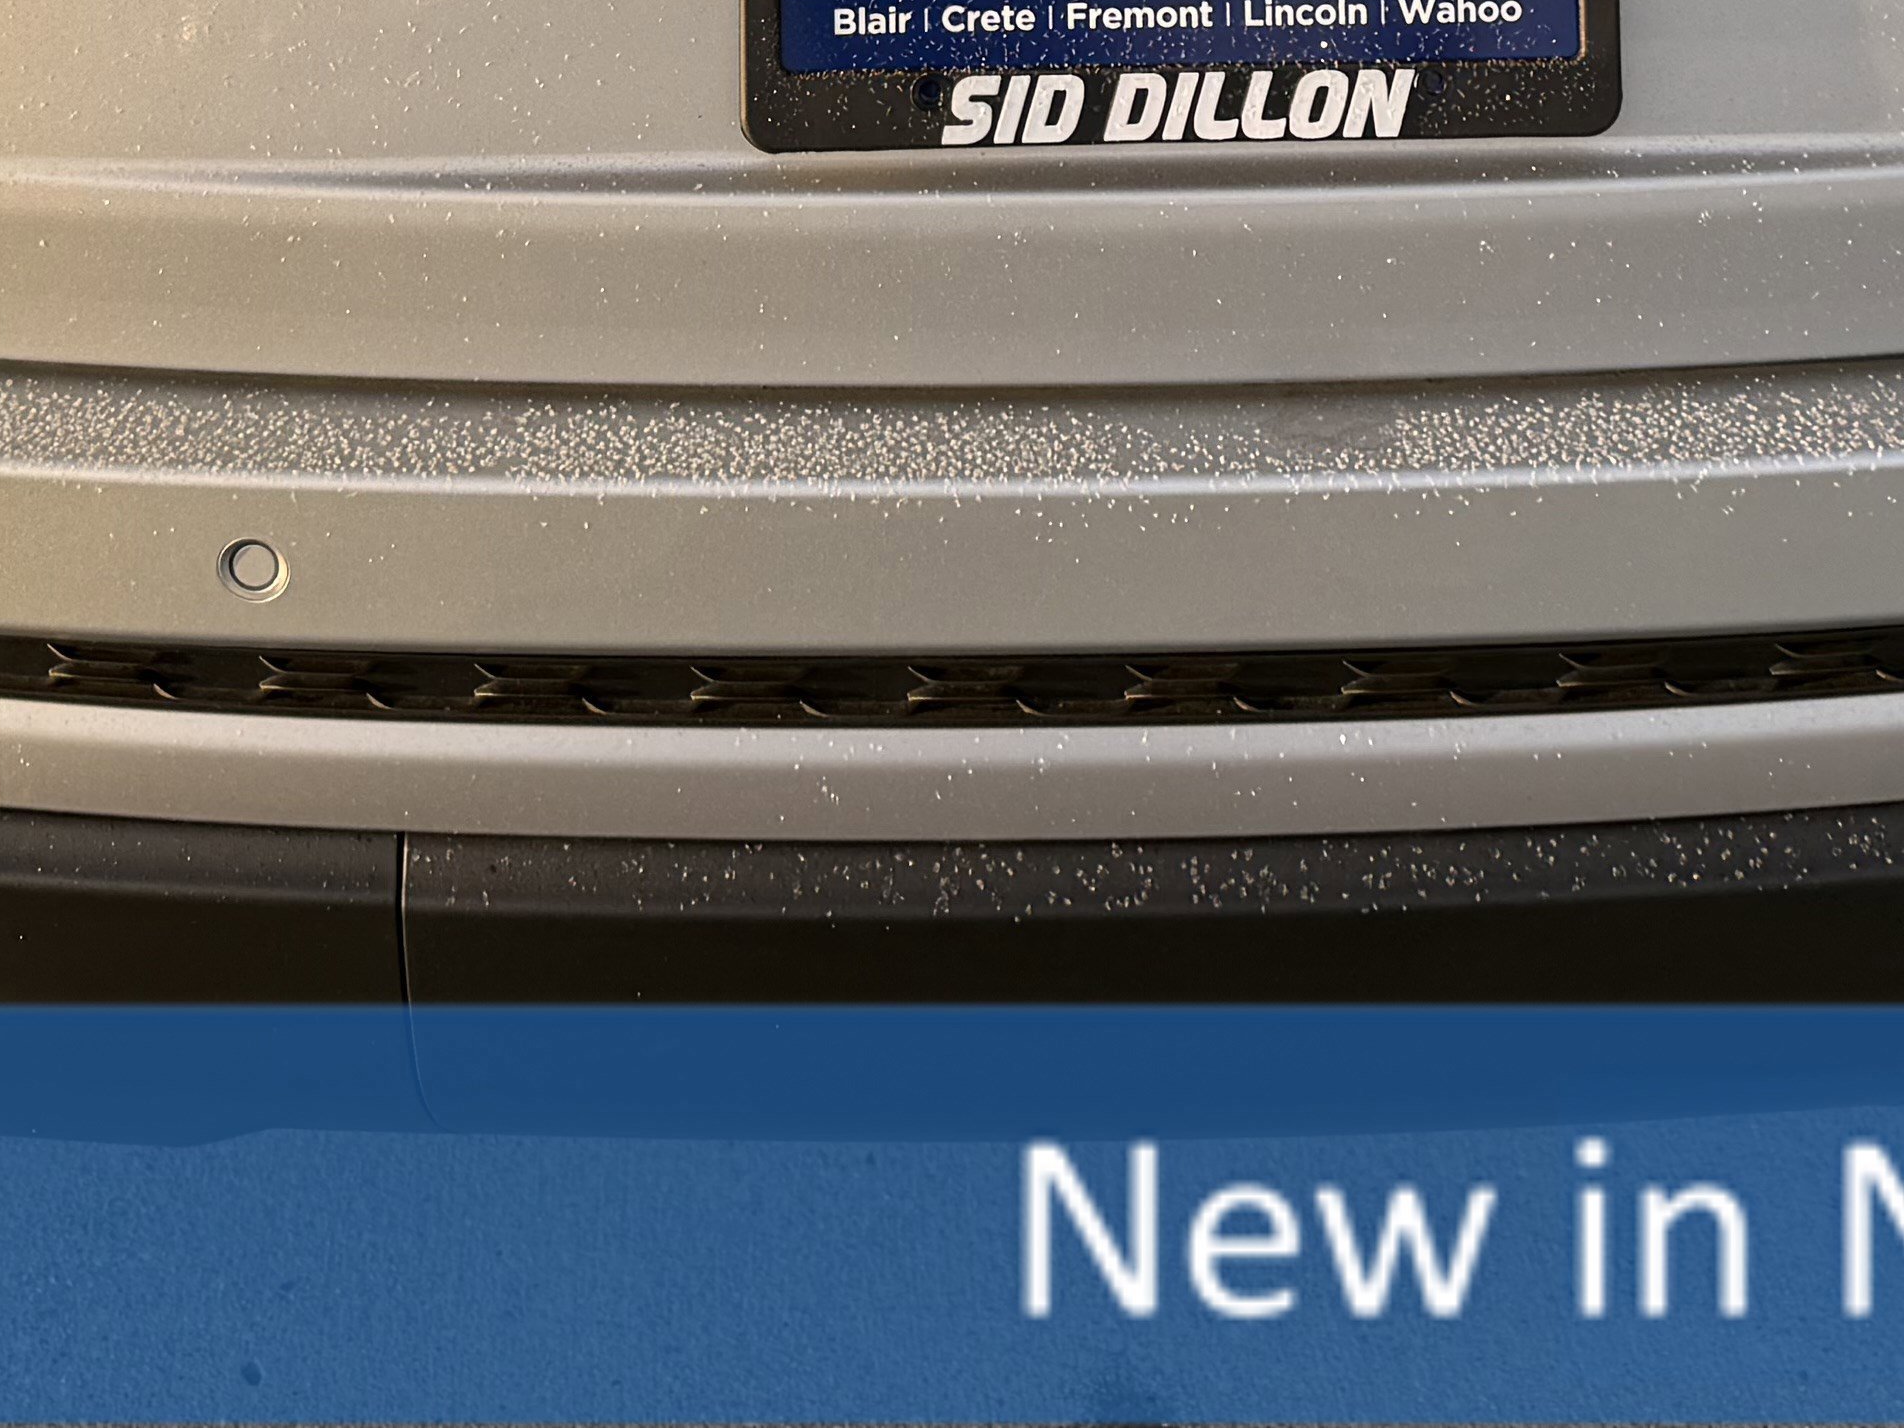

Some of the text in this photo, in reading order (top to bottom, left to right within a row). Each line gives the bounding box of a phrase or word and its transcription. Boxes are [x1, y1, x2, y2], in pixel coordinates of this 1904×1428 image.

[834, 6, 912, 36] Blair
[942, 5, 1036, 34] Crete
[1067, 1, 1214, 29] Fremont
[1244, 0, 1369, 27] Lincoln
[942, 69, 1416, 145] SID DILLON
